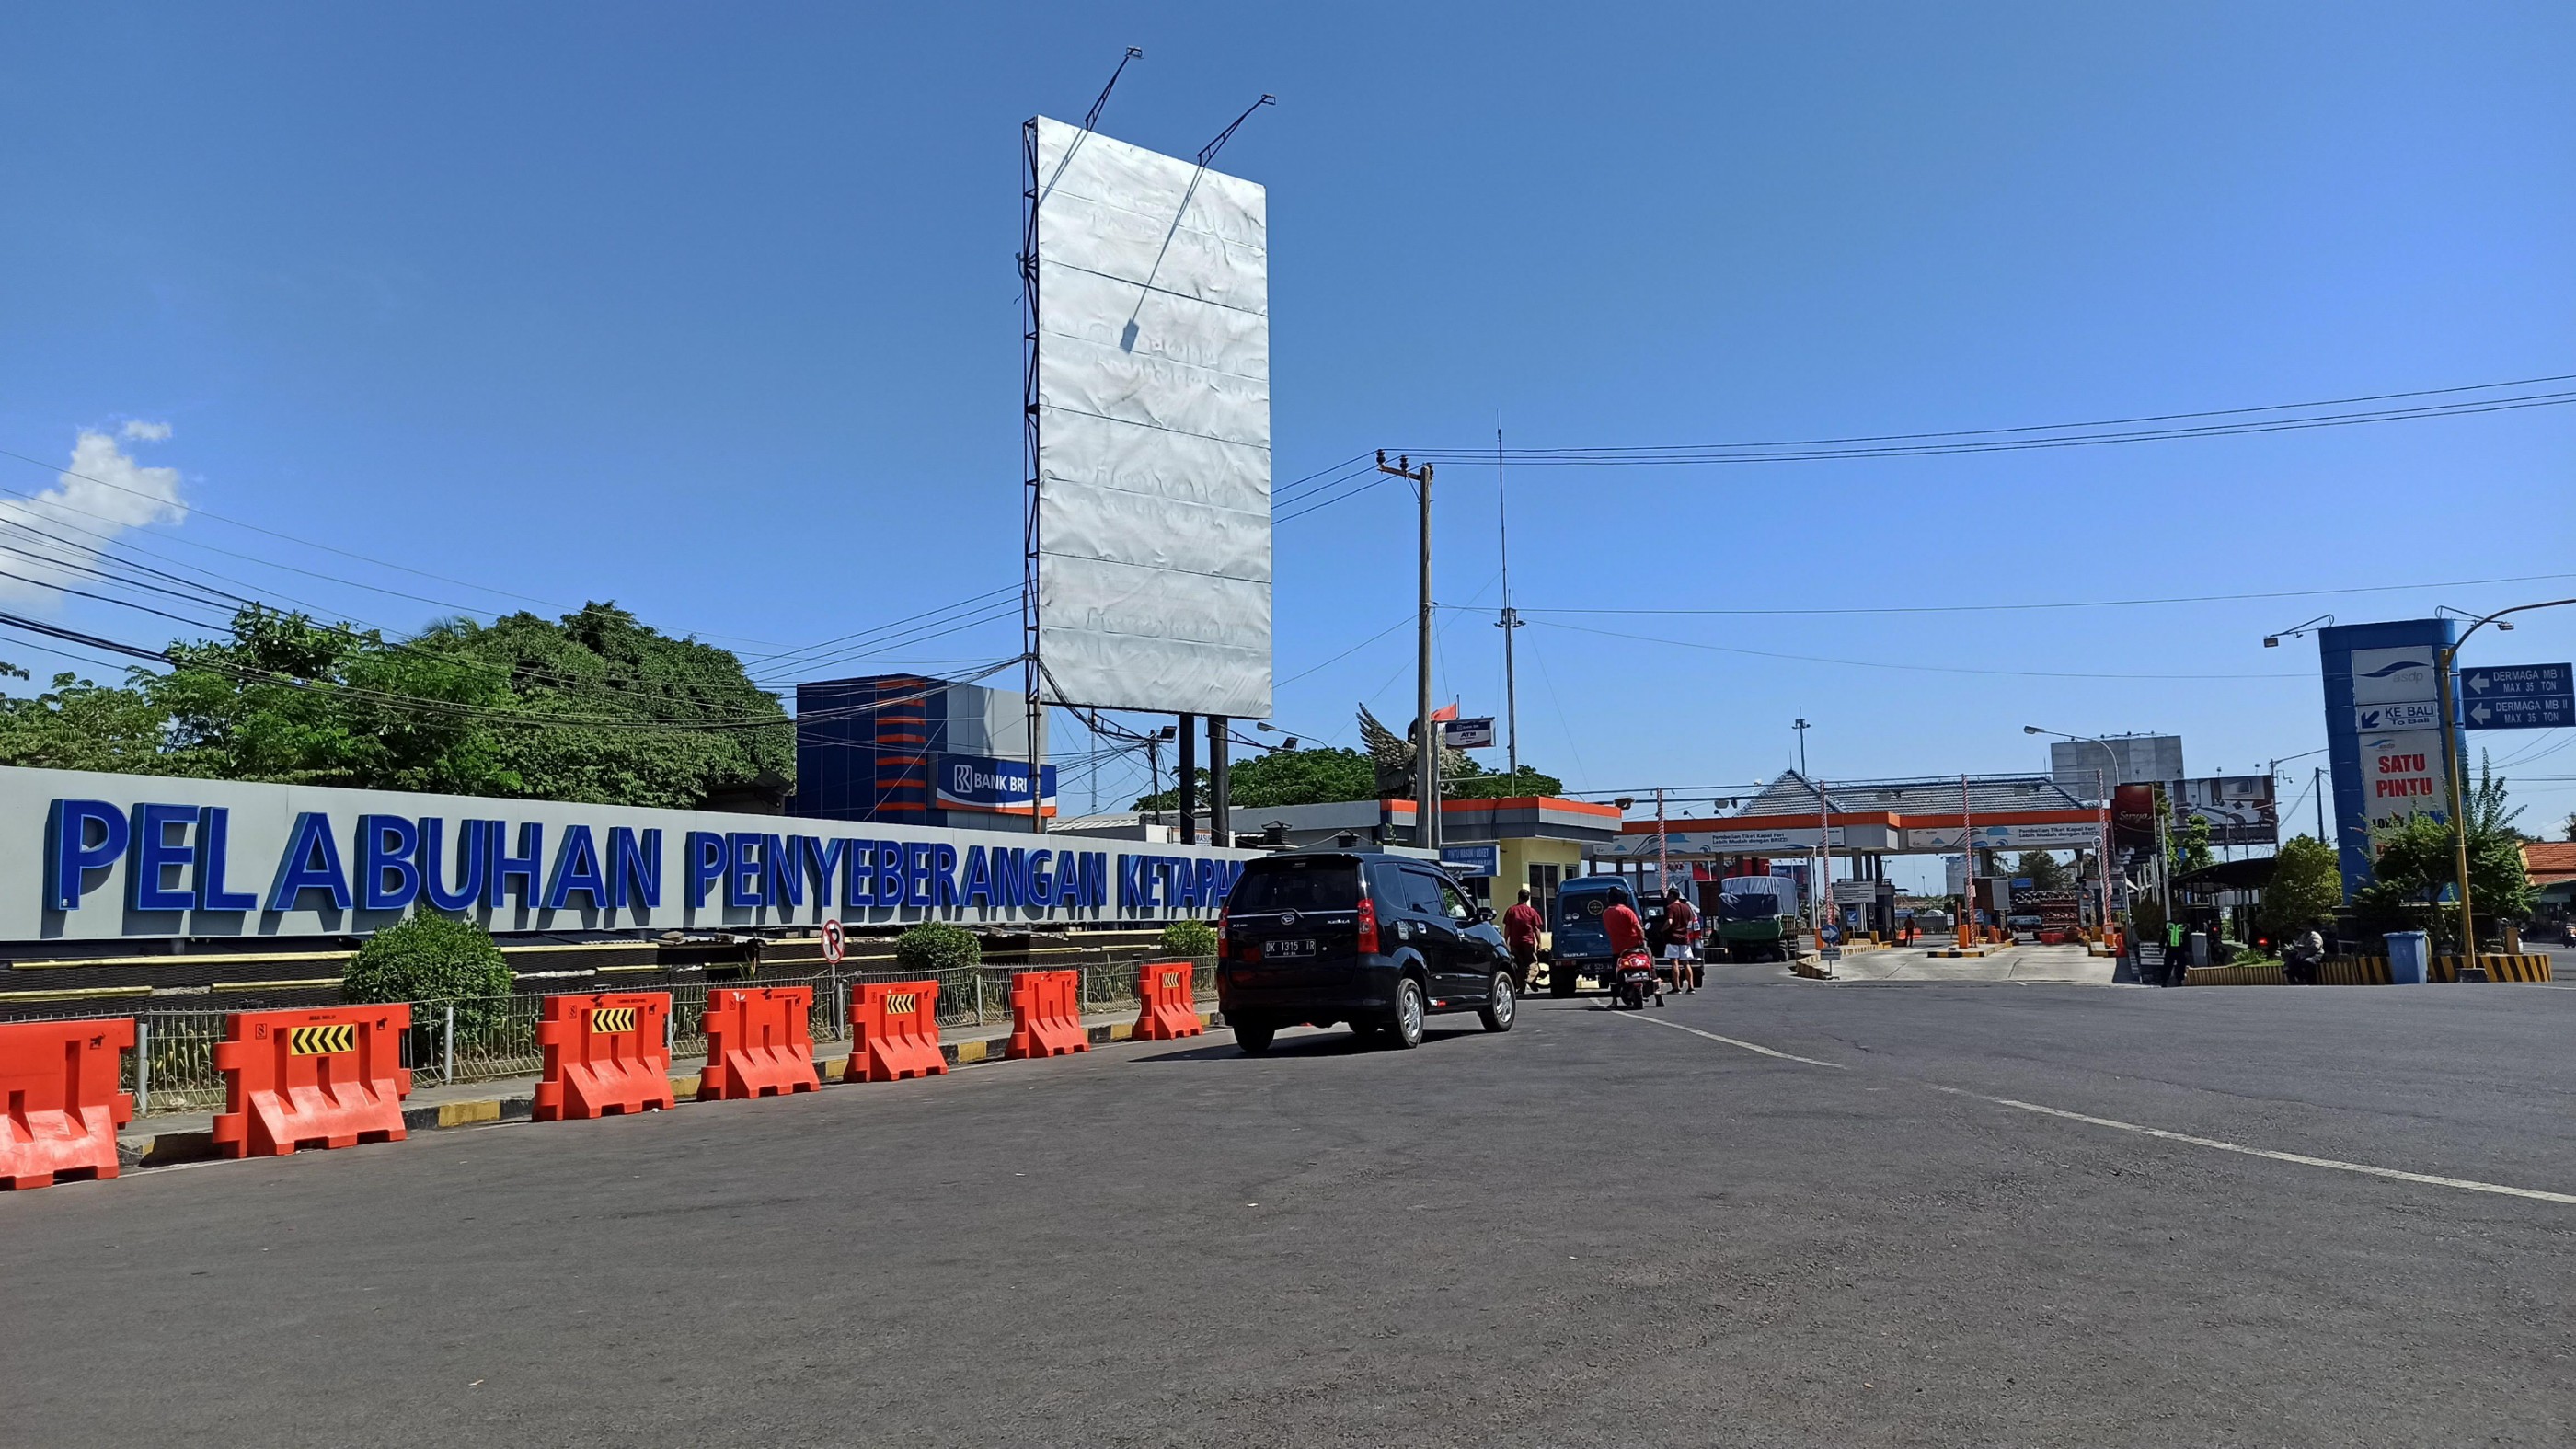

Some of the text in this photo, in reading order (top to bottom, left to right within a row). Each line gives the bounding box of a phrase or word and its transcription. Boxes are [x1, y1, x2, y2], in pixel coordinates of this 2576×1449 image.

[2393, 672, 2424, 684] asdp
[2493, 669, 2539, 682] DERMAGA
[2543, 669, 2558, 679] MB
[2503, 681, 2557, 693] MAX 35 TON
[2385, 706, 2434, 718] KE BALI
[2495, 700, 2541, 712] DERMAGA
[2545, 700, 2559, 709] MB
[2504, 712, 2559, 723] MAX 35 TON
[2378, 753, 2426, 774] SATU
[974, 773, 1027, 793] BANK BRI
[2376, 777, 2432, 798] PINTU
[50, 799, 662, 911] PELABUHAN
[687, 832, 1107, 908] PENYEBERANGAN
[829, 928, 840, 955] P
[1266, 942, 1275, 952] DK
[1282, 941, 1298, 951] 1315
